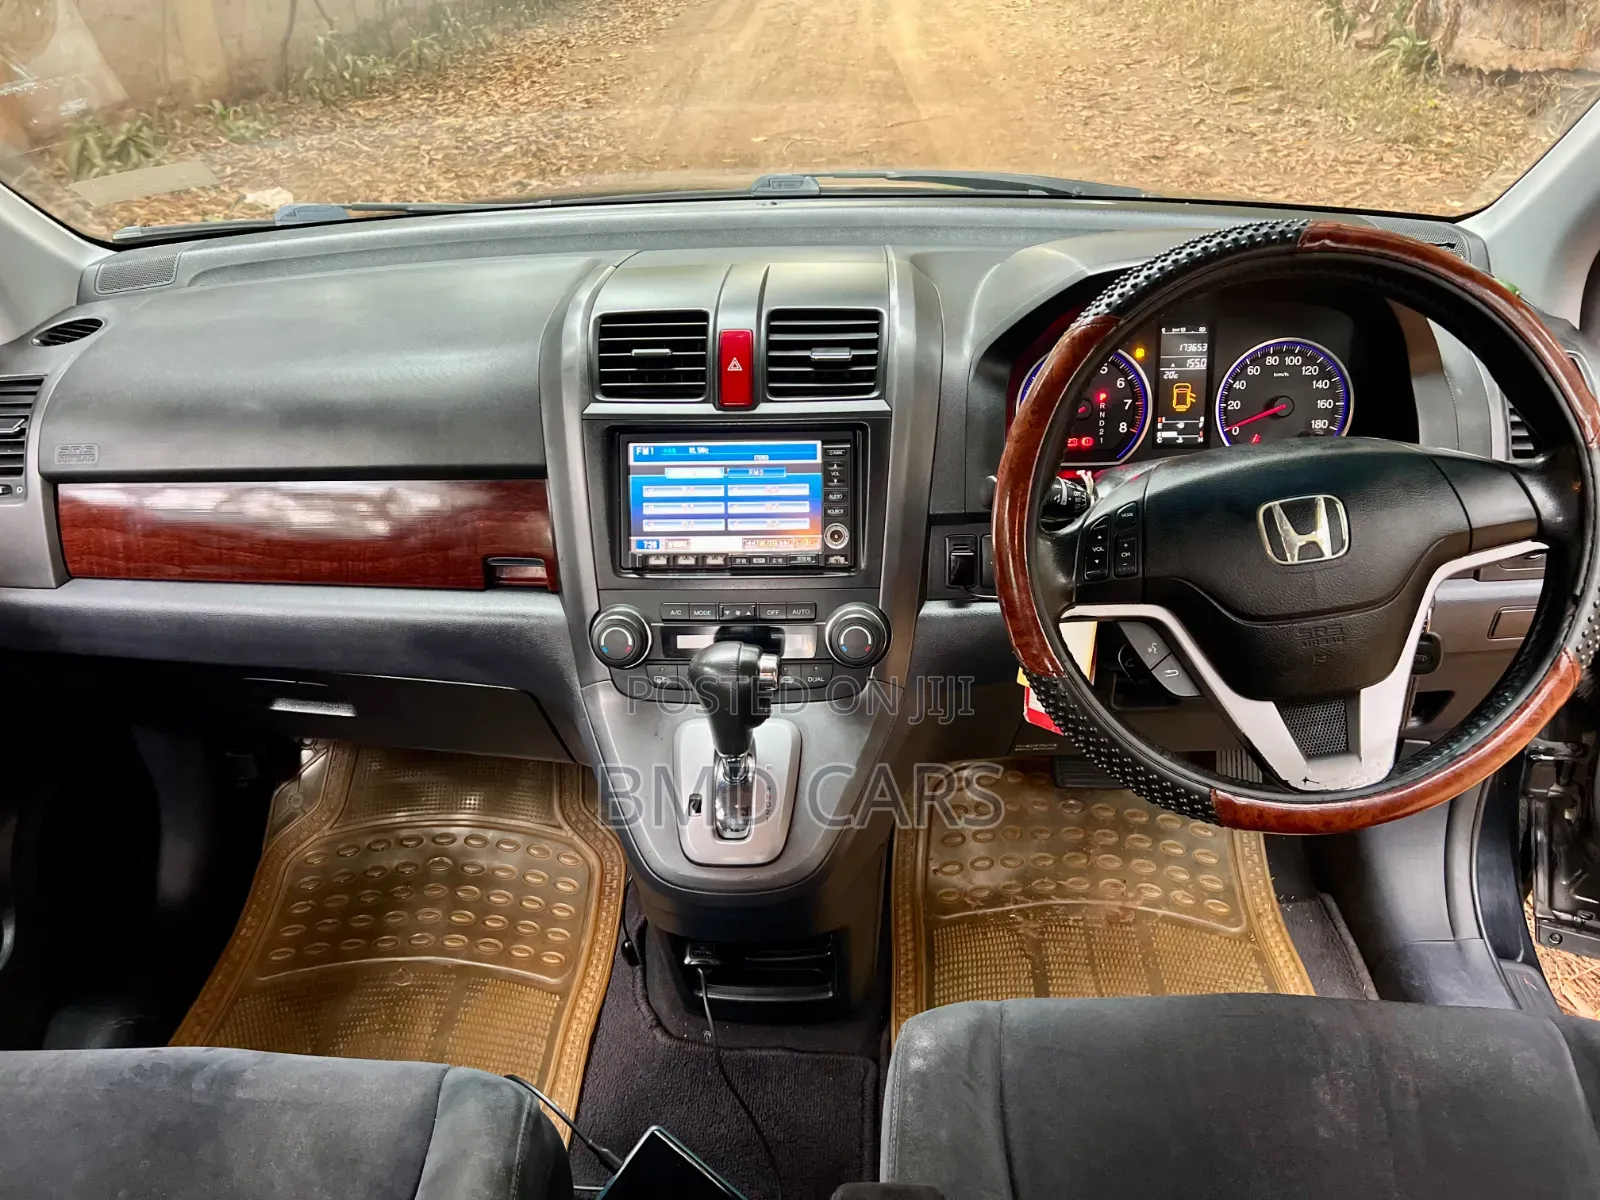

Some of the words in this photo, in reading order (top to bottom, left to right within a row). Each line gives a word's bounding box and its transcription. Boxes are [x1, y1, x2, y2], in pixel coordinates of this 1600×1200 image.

[1179, 343, 1208, 352] 173653
[1266, 356, 1279, 366] 80
[1284, 356, 1302, 366] 100
[1100, 363, 1108, 374] 5
[1247, 366, 1261, 376] 60
[1301, 366, 1319, 375] 120
[1117, 378, 1125, 388] 6
[1233, 380, 1246, 390] 40
[1312, 380, 1330, 389] 140
[1124, 400, 1132, 410] 7
[1227, 400, 1241, 410] 20
[1316, 399, 1334, 409] 160
[1119, 422, 1127, 433] 8
[1311, 419, 1328, 429] 180
[1231, 426, 1239, 436] 0
